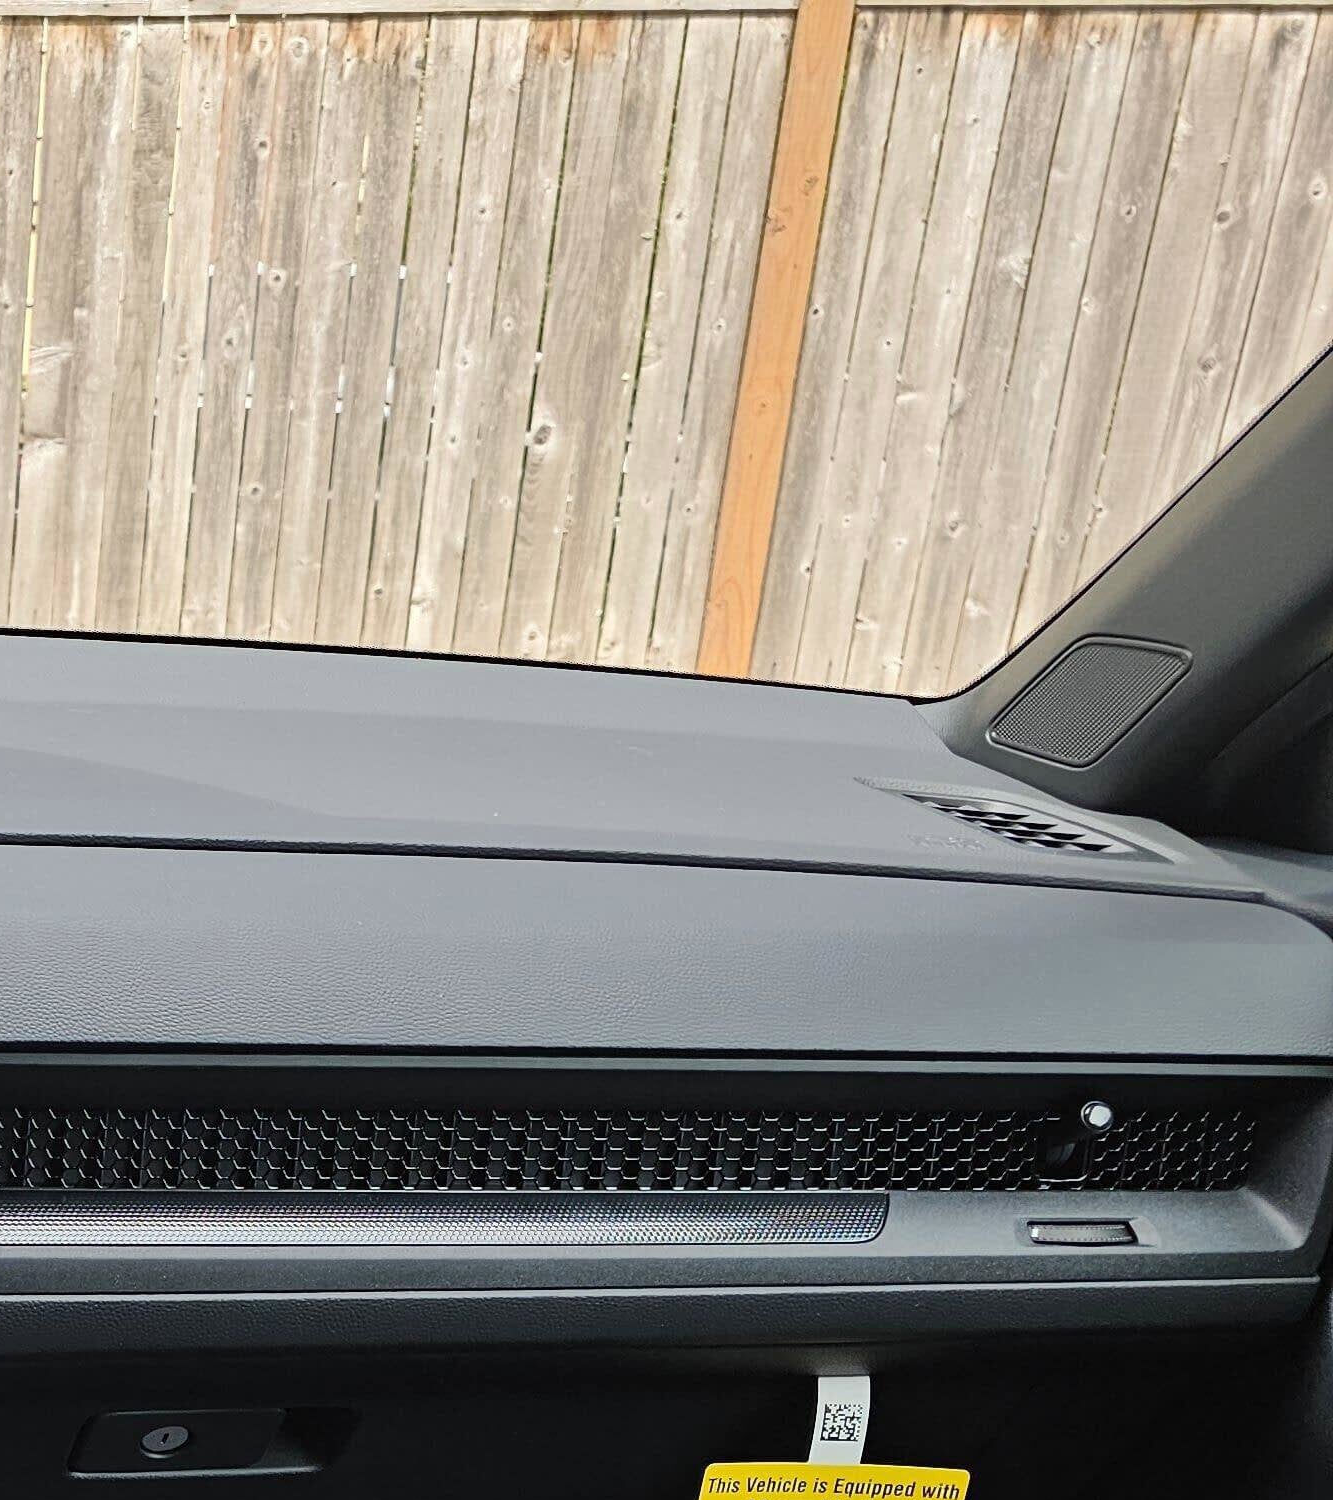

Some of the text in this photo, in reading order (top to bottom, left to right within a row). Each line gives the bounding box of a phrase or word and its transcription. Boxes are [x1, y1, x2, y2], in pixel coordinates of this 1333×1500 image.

[708, 1477, 960, 1500] This Vehicle is Equipped with
